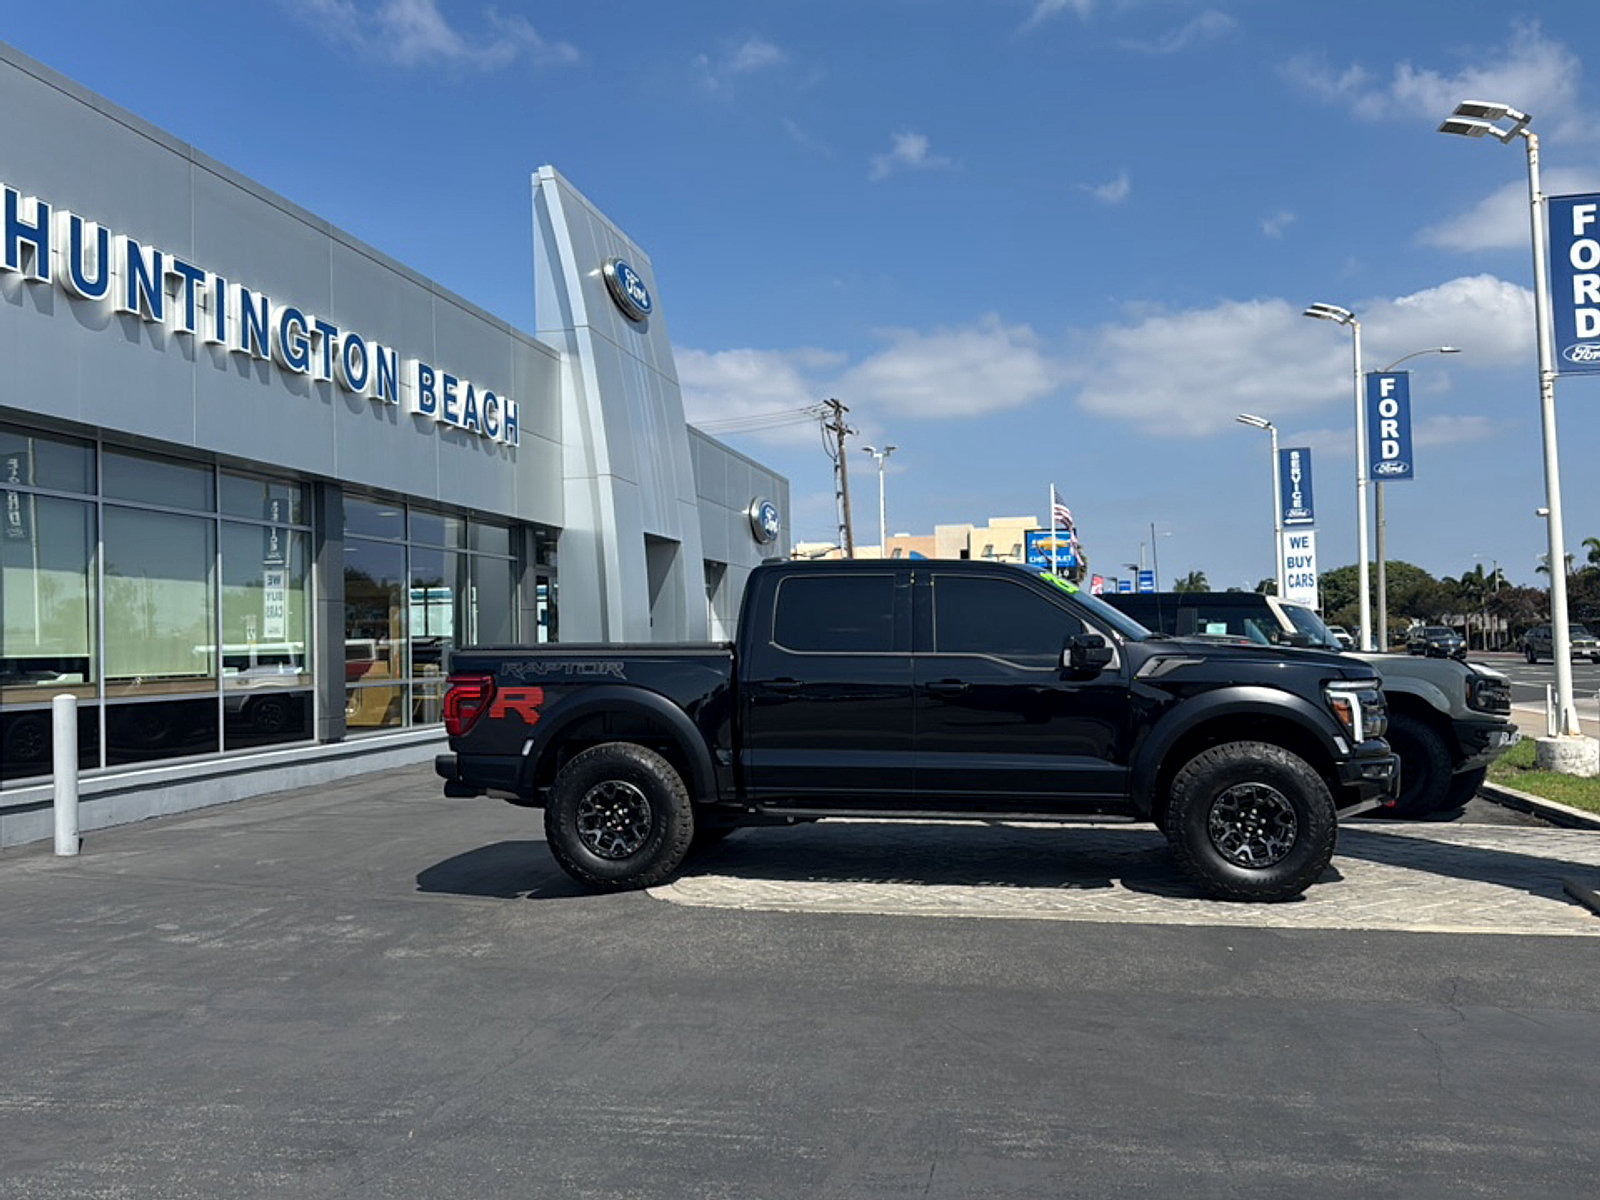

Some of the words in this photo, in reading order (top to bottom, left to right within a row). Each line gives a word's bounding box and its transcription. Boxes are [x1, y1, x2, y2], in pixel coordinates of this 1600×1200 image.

[1569, 203, 1600, 339] FORD
[624, 267, 649, 308] Ford
[0, 182, 399, 406] HUNTINGTON
[414, 360, 519, 447] BEACH
[1570, 344, 1600, 362] For
[1379, 378, 1400, 460] FORD
[1377, 462, 1406, 475] Ford
[1290, 451, 1302, 508] SERVICE
[1289, 536, 1310, 550] WE
[1028, 555, 1072, 563] CHELET
[1286, 555, 1313, 570] BUY
[1288, 573, 1315, 589] CARS
[501, 661, 627, 681] RAPTOR
